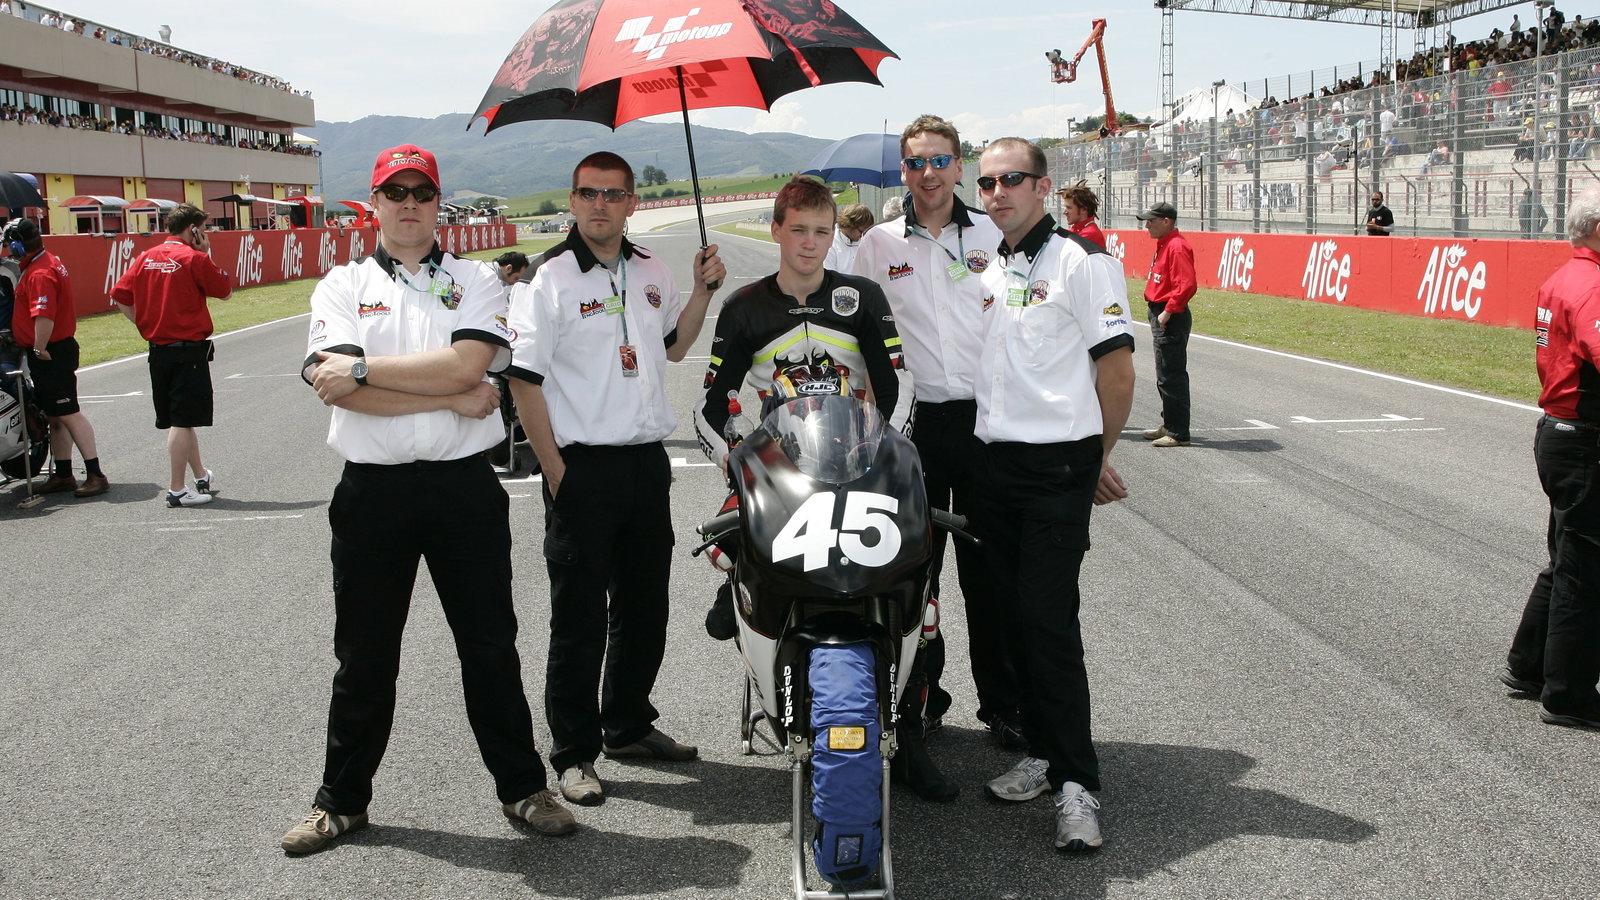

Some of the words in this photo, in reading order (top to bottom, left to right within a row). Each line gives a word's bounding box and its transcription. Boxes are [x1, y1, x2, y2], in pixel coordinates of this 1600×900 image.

[658, 22, 733, 46] motogp
[236, 233, 263, 287] Alice
[281, 232, 303, 279] Alice
[317, 231, 337, 274] Alice
[1217, 236, 1254, 291] Alice
[1301, 239, 1351, 302] Alice
[1417, 243, 1486, 319] Alice
[772, 491, 902, 573] 45
[783, 665, 794, 727] DUNLOP
[889, 663, 898, 723] DUNLOP
